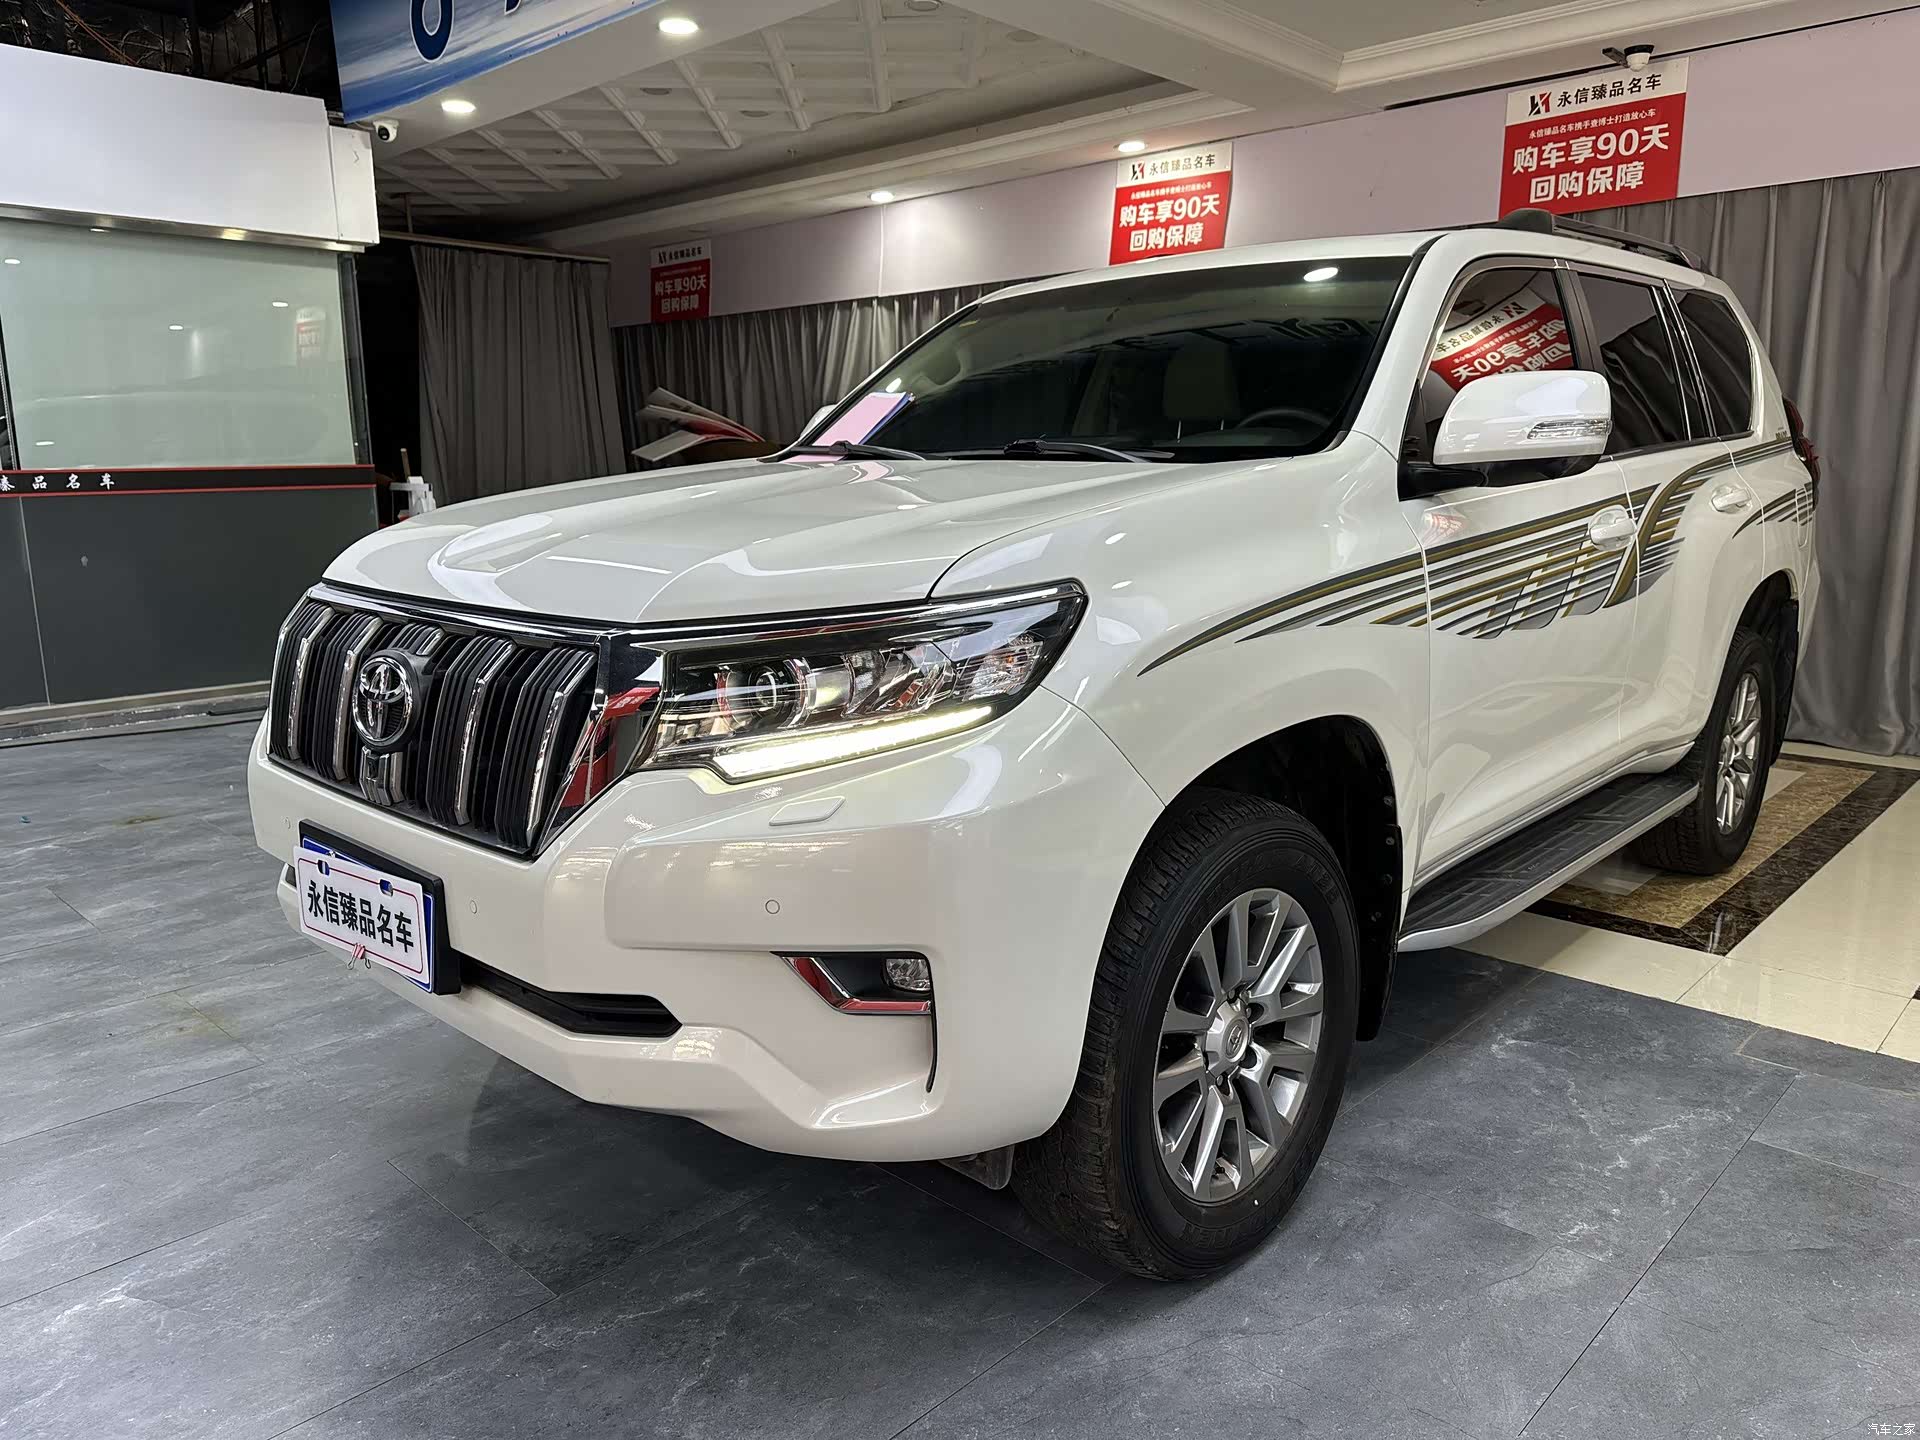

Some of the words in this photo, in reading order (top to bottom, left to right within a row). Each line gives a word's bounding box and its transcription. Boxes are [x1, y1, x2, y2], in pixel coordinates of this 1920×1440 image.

[1557, 74, 1661, 107] 永信臻品名车
[1149, 154, 1215, 176] 永信臻品名车
[1512, 123, 1669, 174] 购车享90天
[1529, 161, 1645, 204] 回购保障
[1119, 194, 1220, 227] 购车享90天
[1130, 222, 1204, 252] 回购保障
[308, 880, 414, 953] 永信臻品名车
